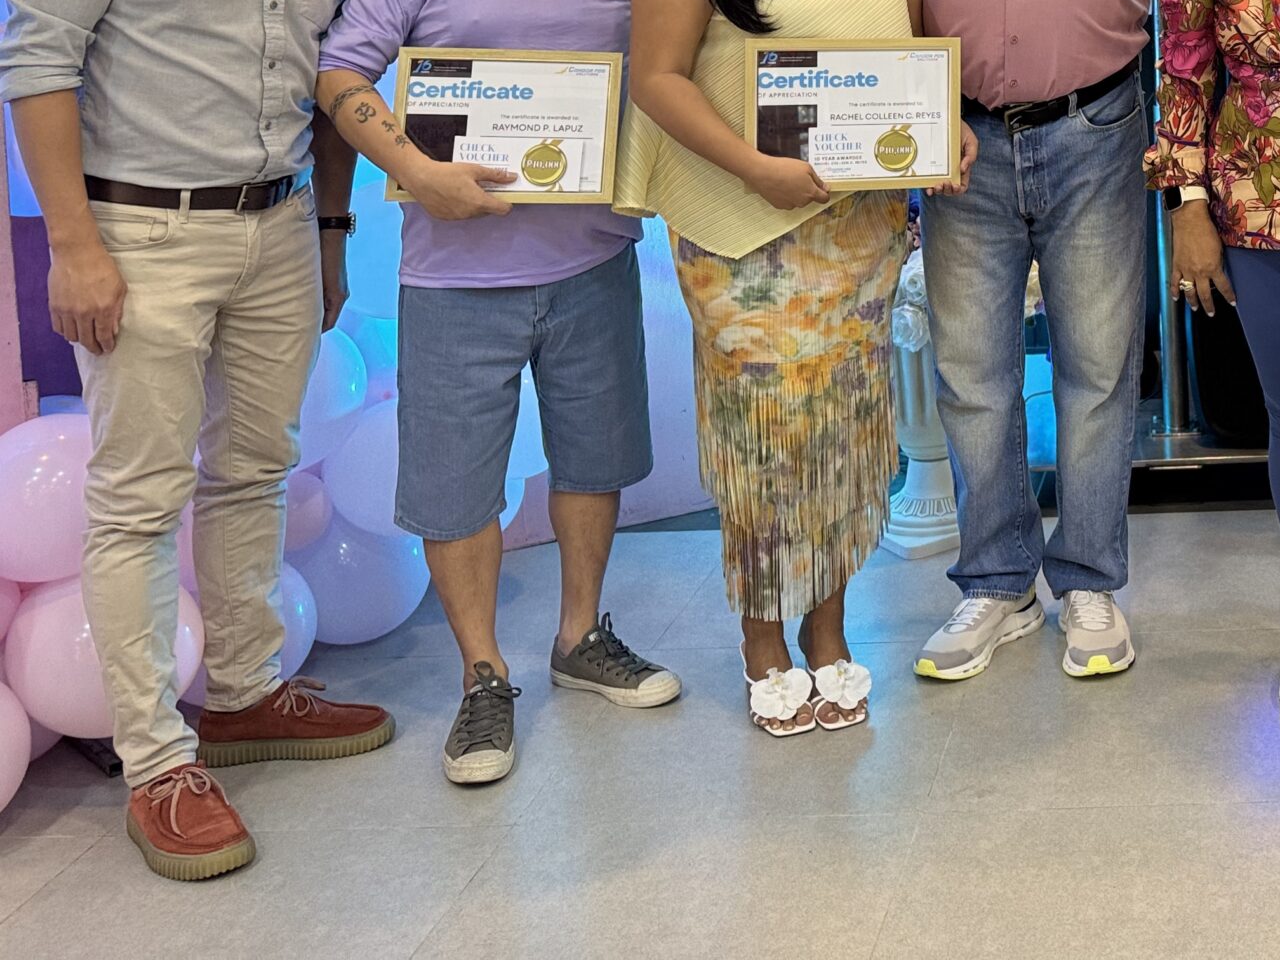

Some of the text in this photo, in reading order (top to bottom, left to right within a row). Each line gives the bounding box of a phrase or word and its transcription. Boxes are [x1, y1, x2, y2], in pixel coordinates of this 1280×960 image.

[758, 69, 879, 89] Certificate
[408, 80, 534, 100] Certificate
[830, 113, 863, 121] RACHEL
[865, 112, 904, 120] COLLEEN
[916, 111, 941, 119] REYES
[492, 123, 541, 132] RAYMOND
[553, 124, 584, 132] LAPUZ
[814, 133, 848, 142] CHECK
[459, 142, 495, 152] CHECK
[814, 142, 862, 152] VOUCHER
[459, 152, 510, 161] VOUCHER
